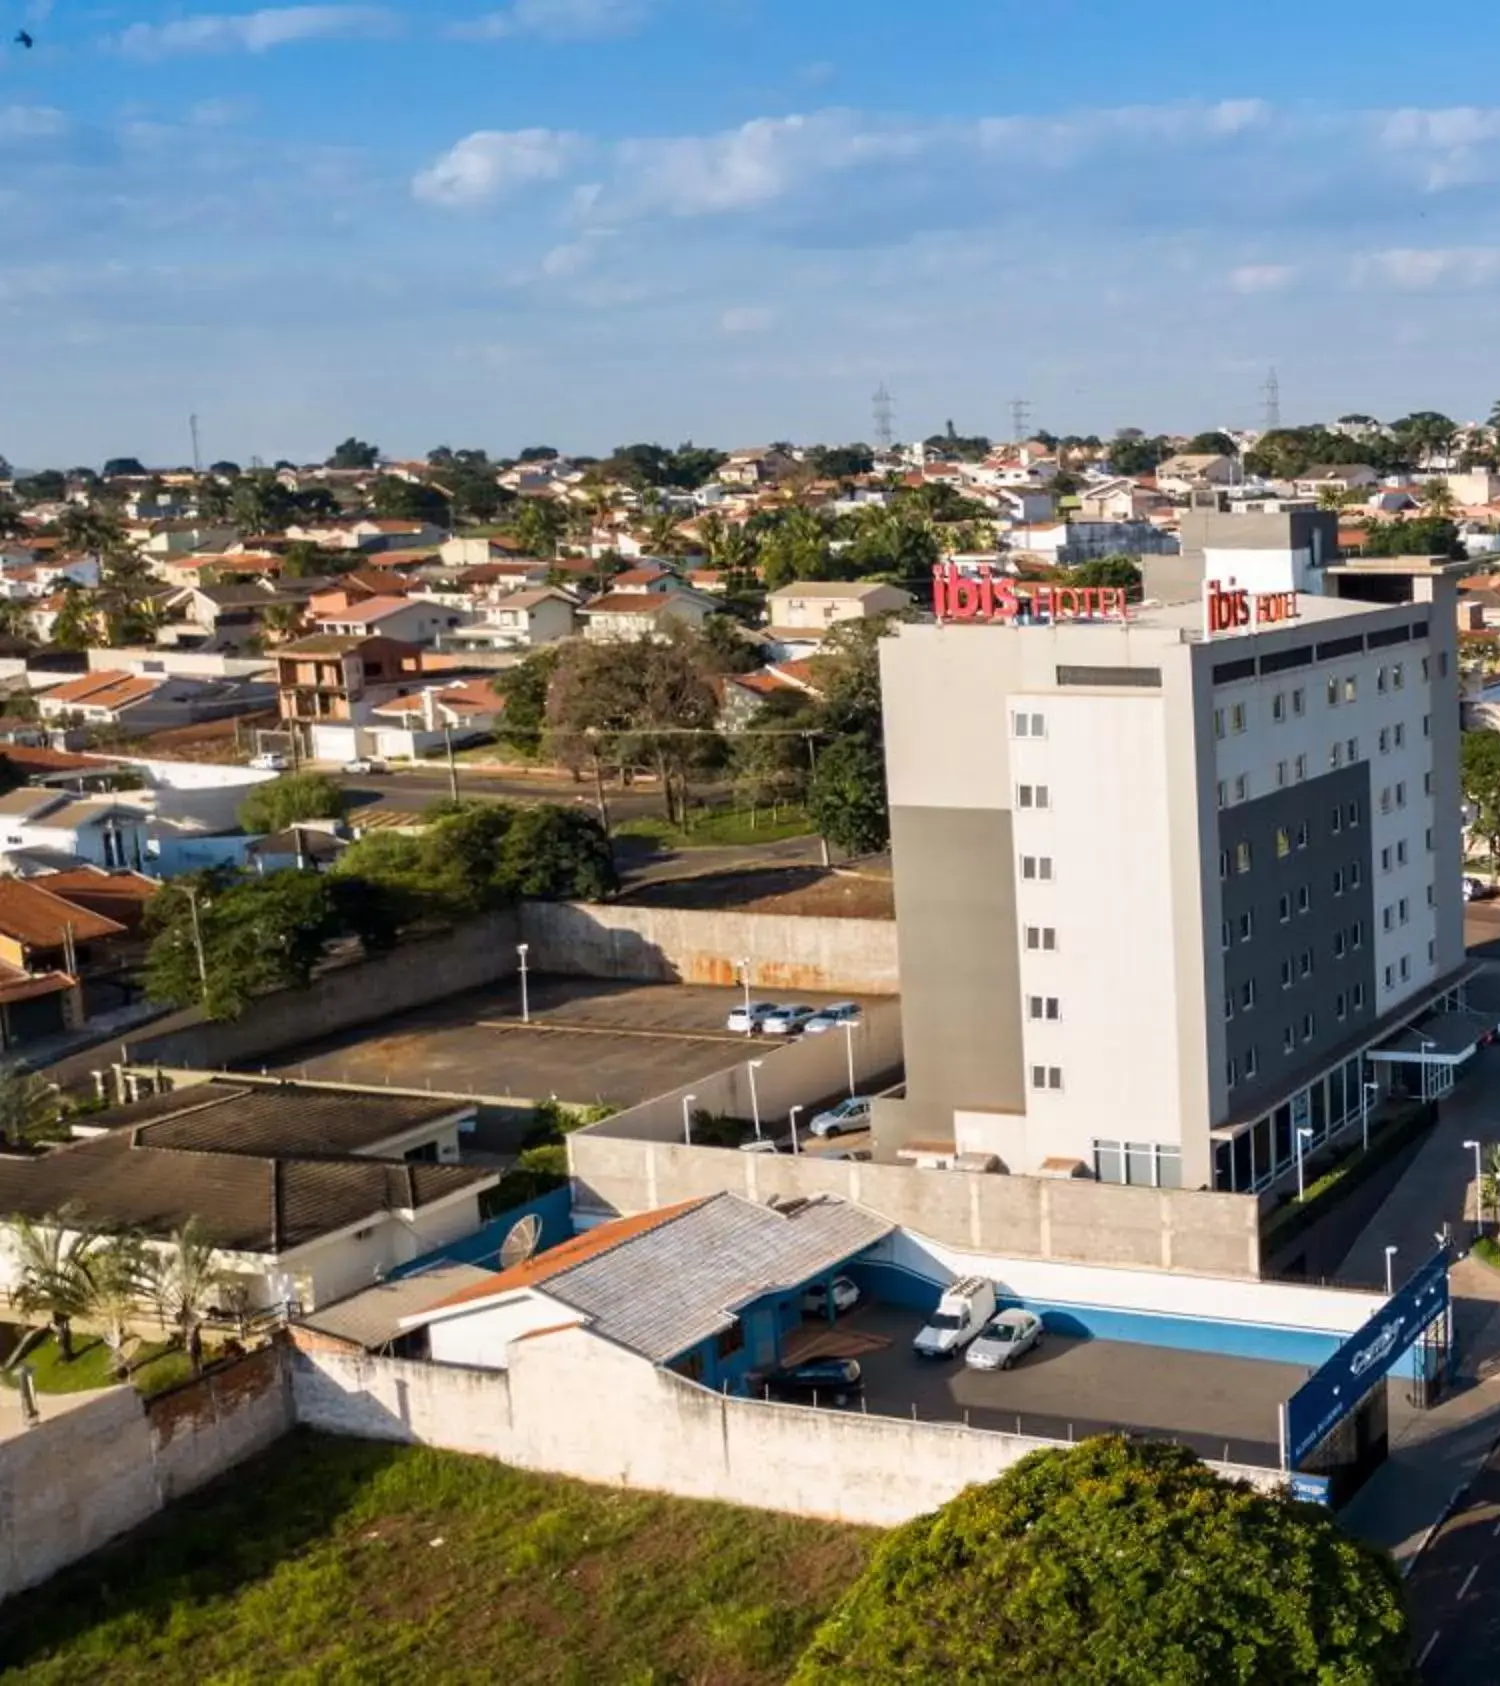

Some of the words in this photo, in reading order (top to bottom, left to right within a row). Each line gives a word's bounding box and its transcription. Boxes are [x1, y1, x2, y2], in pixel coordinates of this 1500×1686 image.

[933, 561, 1018, 618] ibis
[1031, 587, 1135, 619] HOTEL
[1207, 577, 1249, 631] ibis
[1255, 591, 1301, 624] HOTEL
